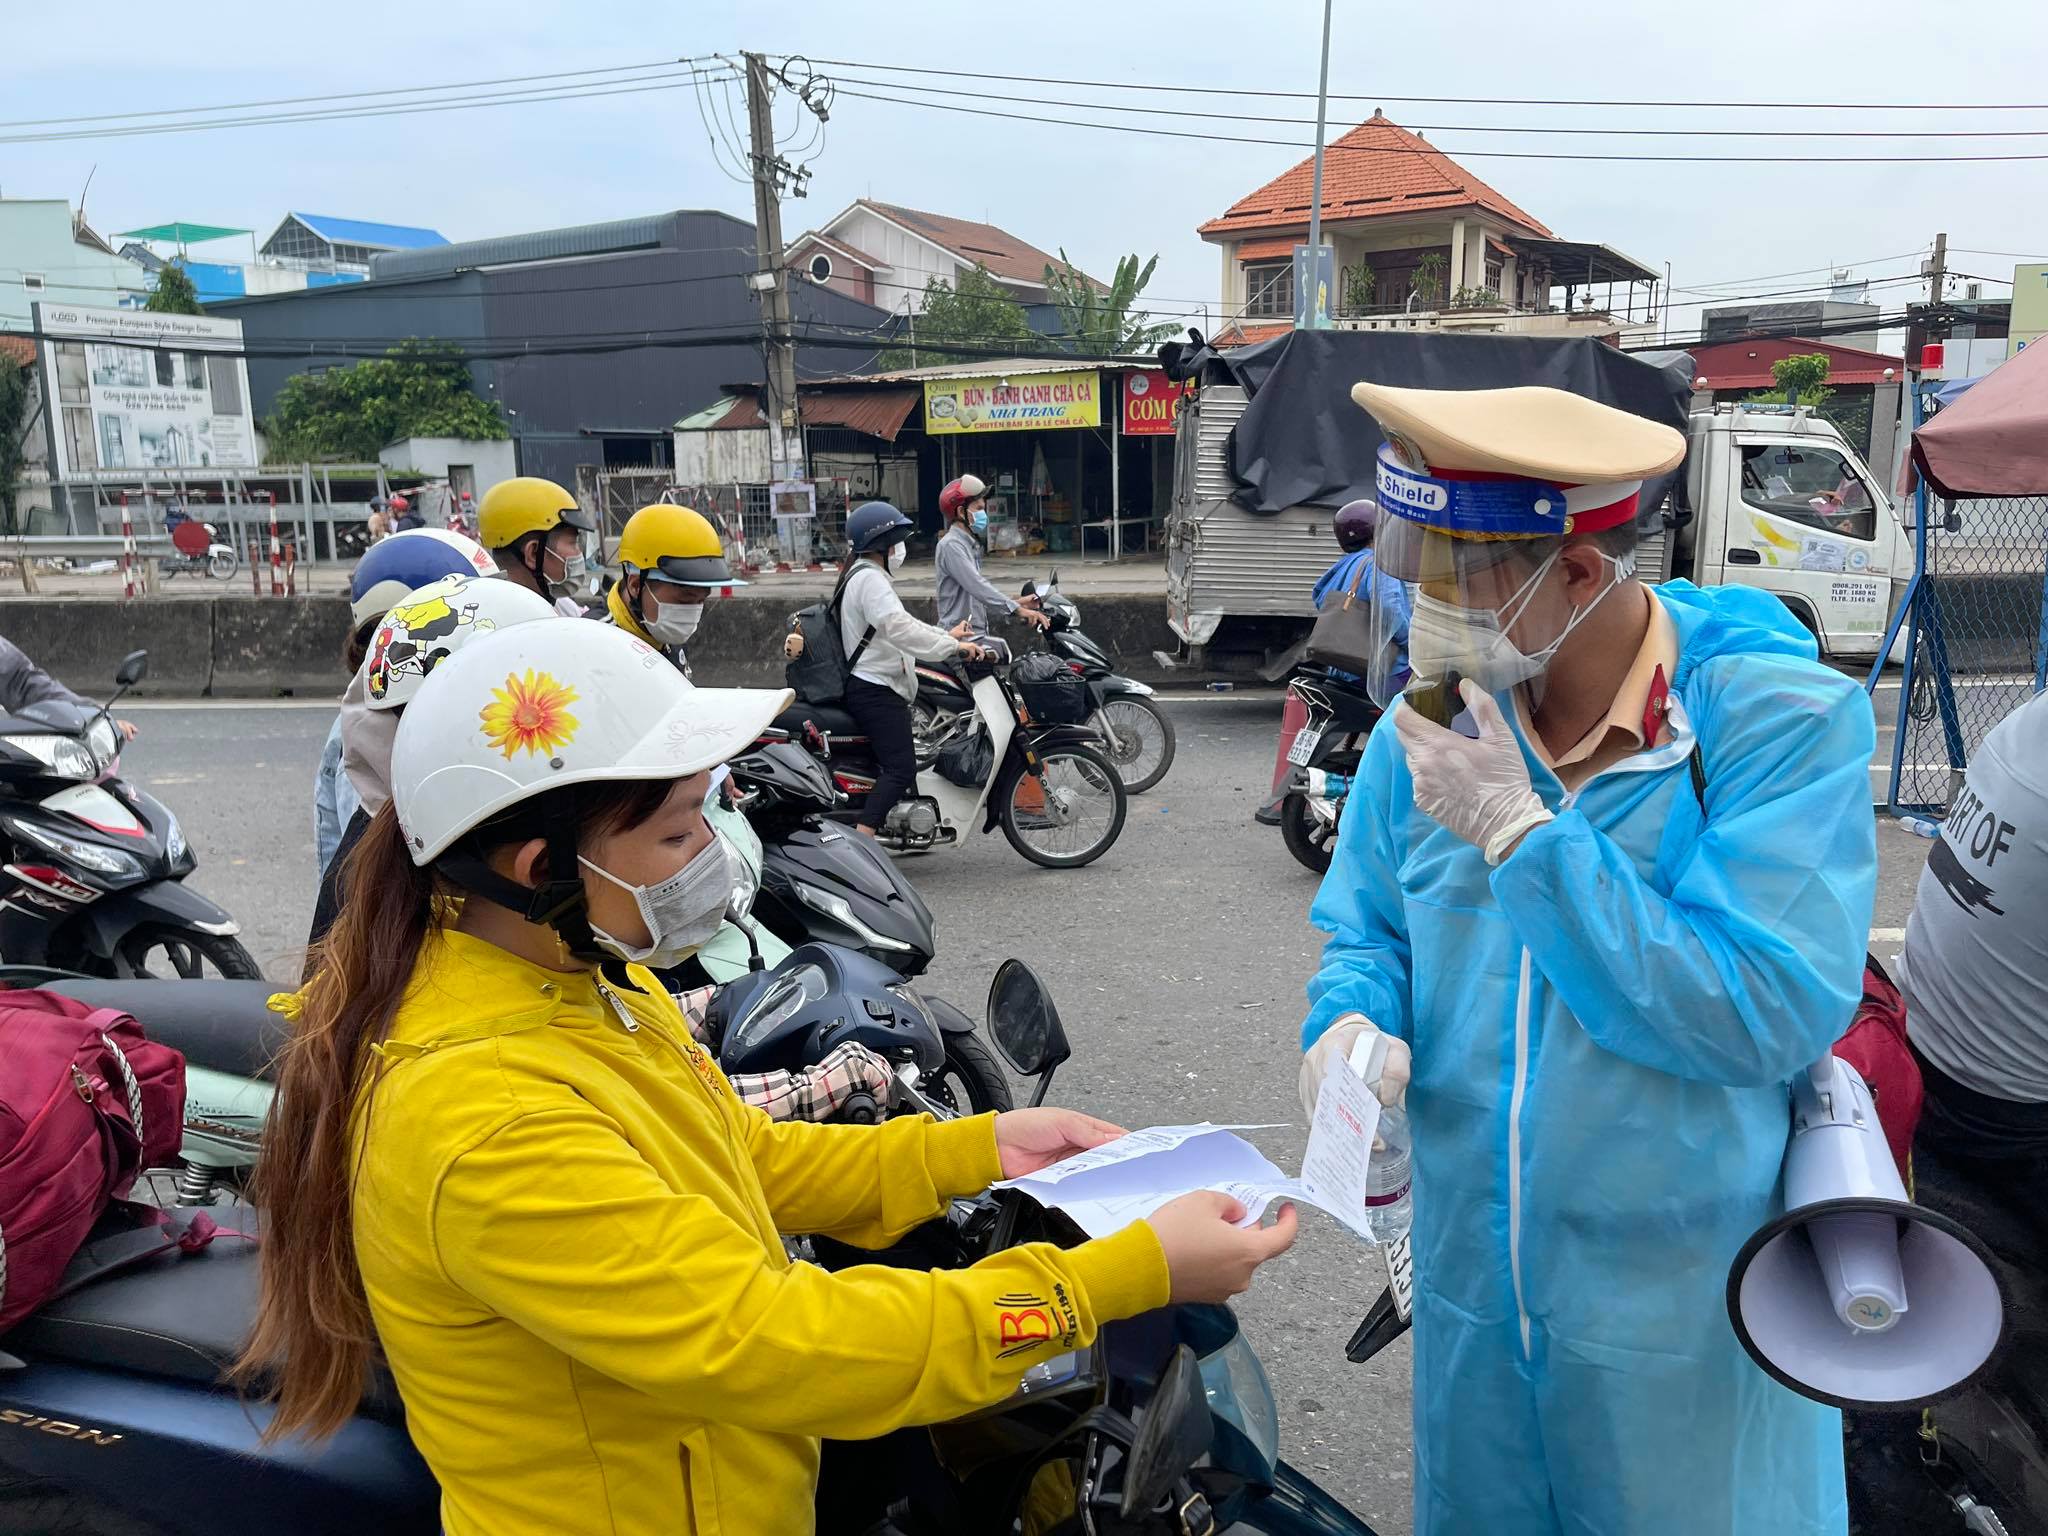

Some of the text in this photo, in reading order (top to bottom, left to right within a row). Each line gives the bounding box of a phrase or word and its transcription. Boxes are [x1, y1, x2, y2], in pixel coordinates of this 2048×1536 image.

[1022, 385, 1051, 404] CANH
[988, 406, 1067, 419] NHA TRANG
[1129, 396, 1168, 421] CƠM
[1384, 475, 1437, 505] Shield
[1970, 811, 2017, 867] OF
